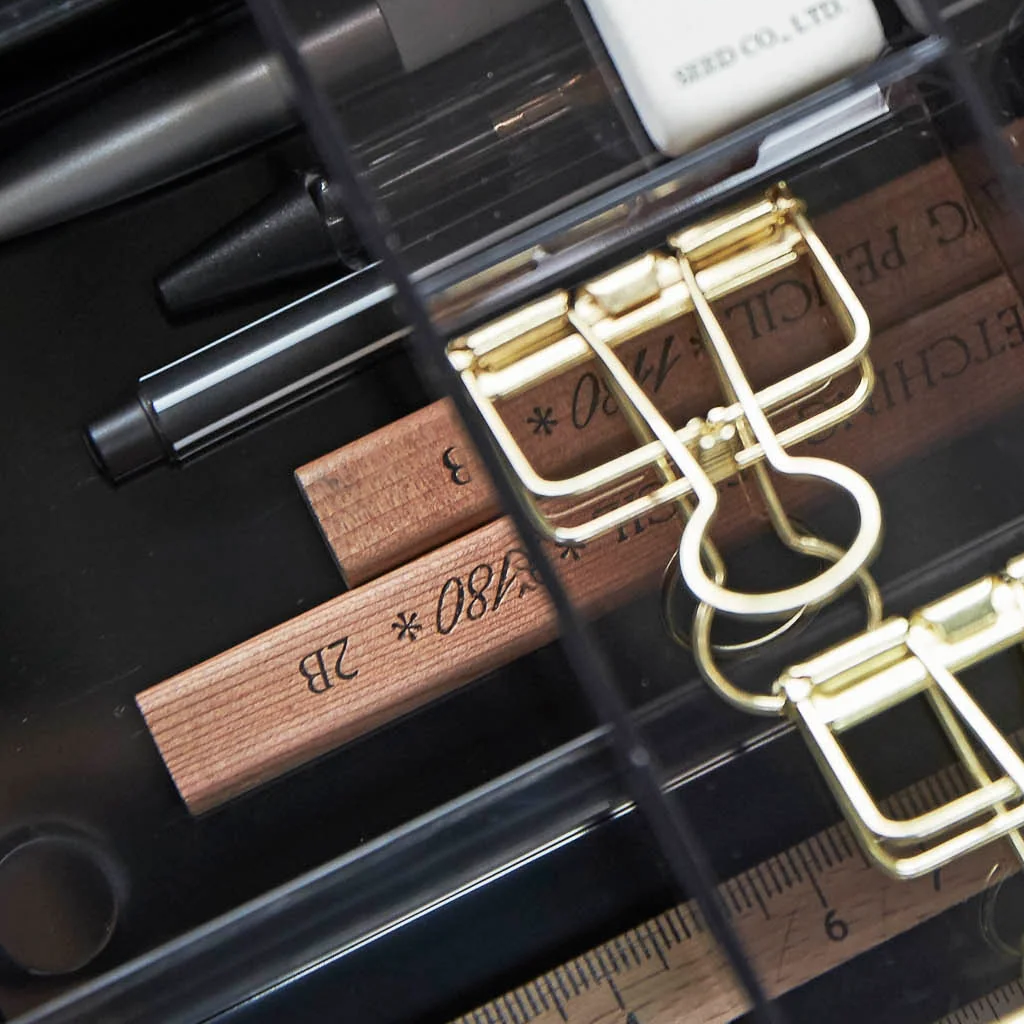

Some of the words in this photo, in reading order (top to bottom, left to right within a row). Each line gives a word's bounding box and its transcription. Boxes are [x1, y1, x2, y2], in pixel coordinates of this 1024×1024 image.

[674, 45, 737, 85] SEED
[300, 636, 360, 693] 2B
[823, 911, 848, 940] 6
